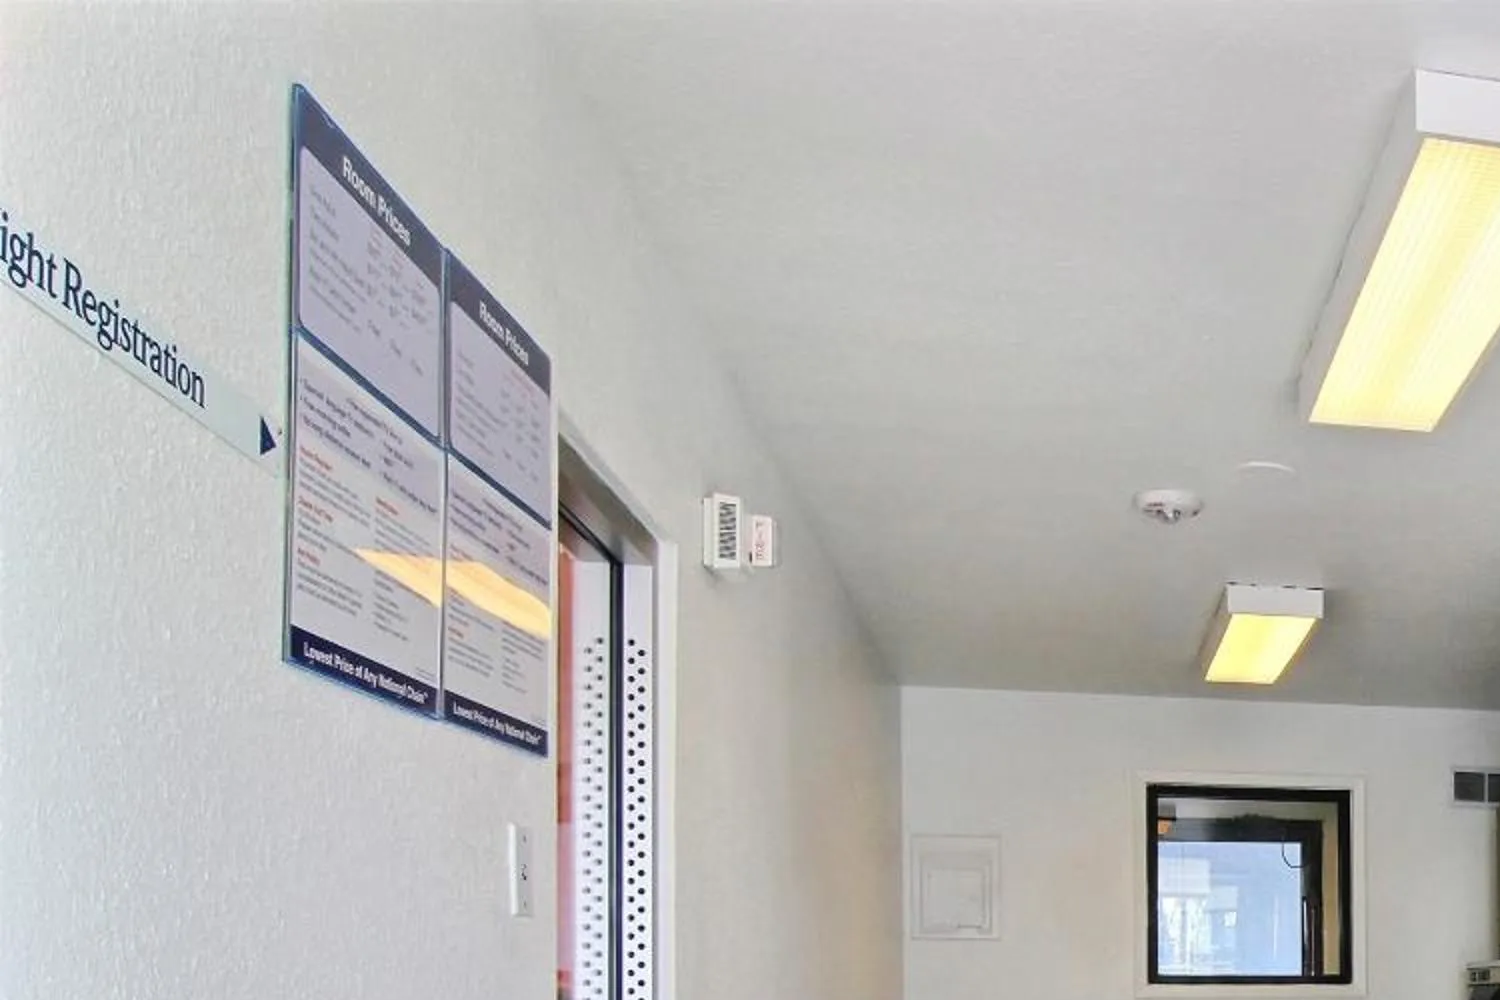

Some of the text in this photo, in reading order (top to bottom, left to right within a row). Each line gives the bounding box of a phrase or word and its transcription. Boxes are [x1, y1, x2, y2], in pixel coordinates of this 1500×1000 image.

[342, 155, 411, 247] Room Prices
[62, 257, 206, 409] Registration
[303, 641, 333, 666] Lowest
[334, 653, 354, 675] Price
